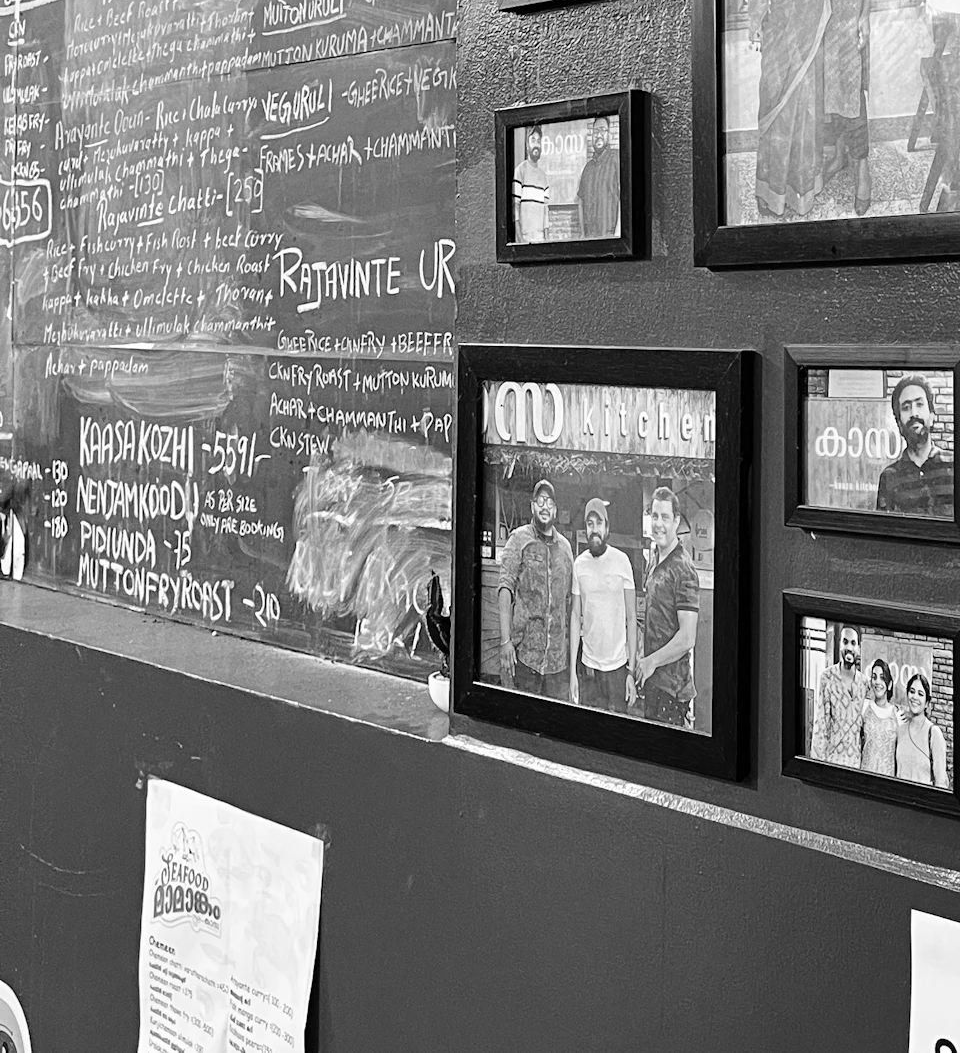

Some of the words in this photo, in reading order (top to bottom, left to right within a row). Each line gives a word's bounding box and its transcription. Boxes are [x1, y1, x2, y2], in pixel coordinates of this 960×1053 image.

[272, 247, 401, 314] RAJAVINTE
[581, 396, 716, 443] kitchen
[160, 852, 210, 892] SEAFOOD
